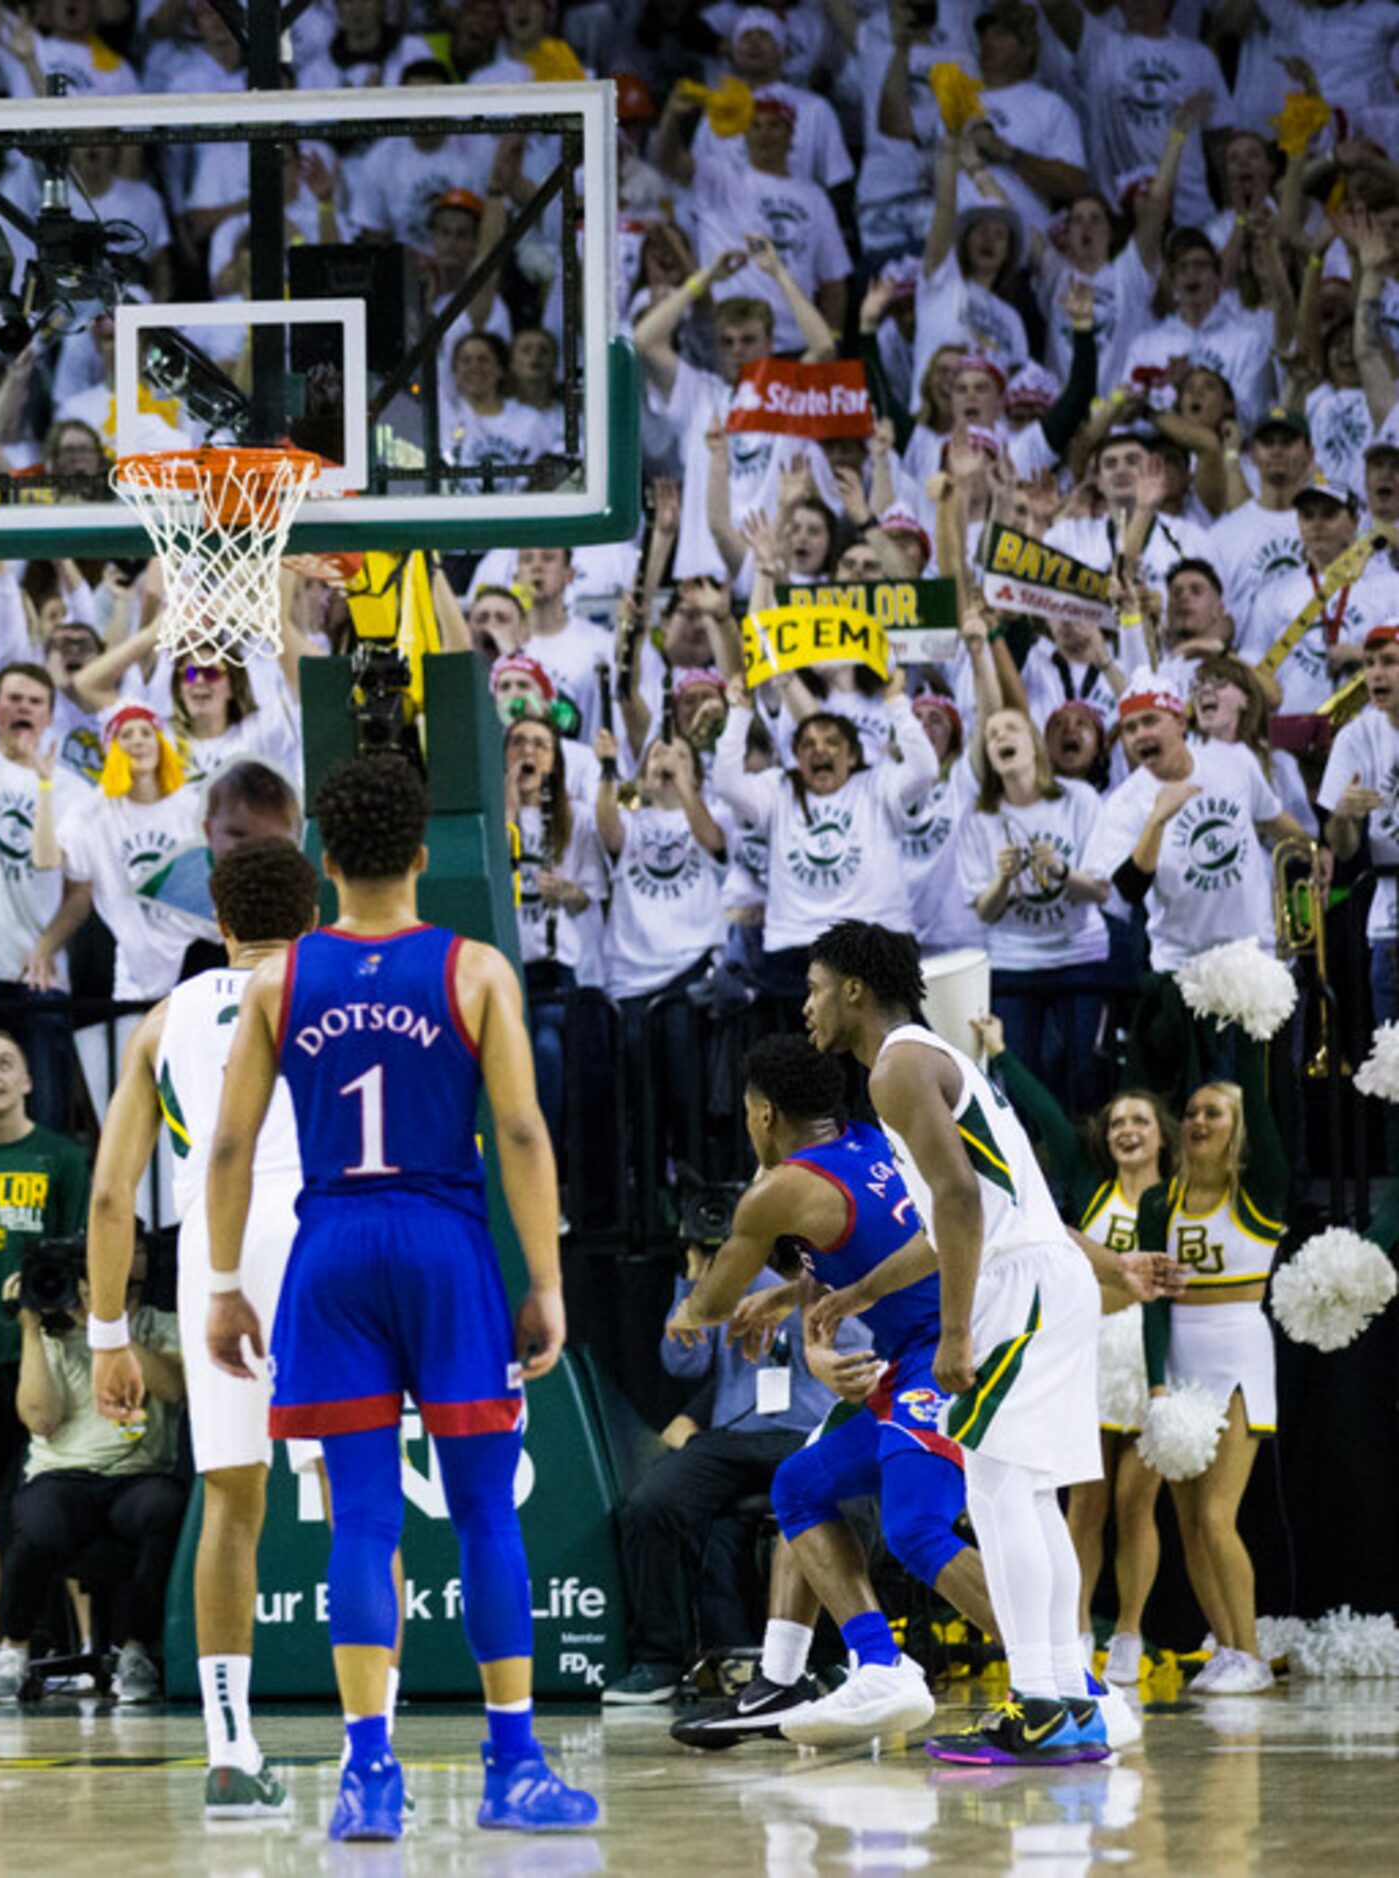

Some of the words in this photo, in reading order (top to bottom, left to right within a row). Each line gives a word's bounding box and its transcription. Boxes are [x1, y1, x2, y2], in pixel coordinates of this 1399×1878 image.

[295, 1003, 440, 1057] DOTSON
[339, 1064, 401, 1176] 1
[1177, 1225, 1225, 1274] BU
